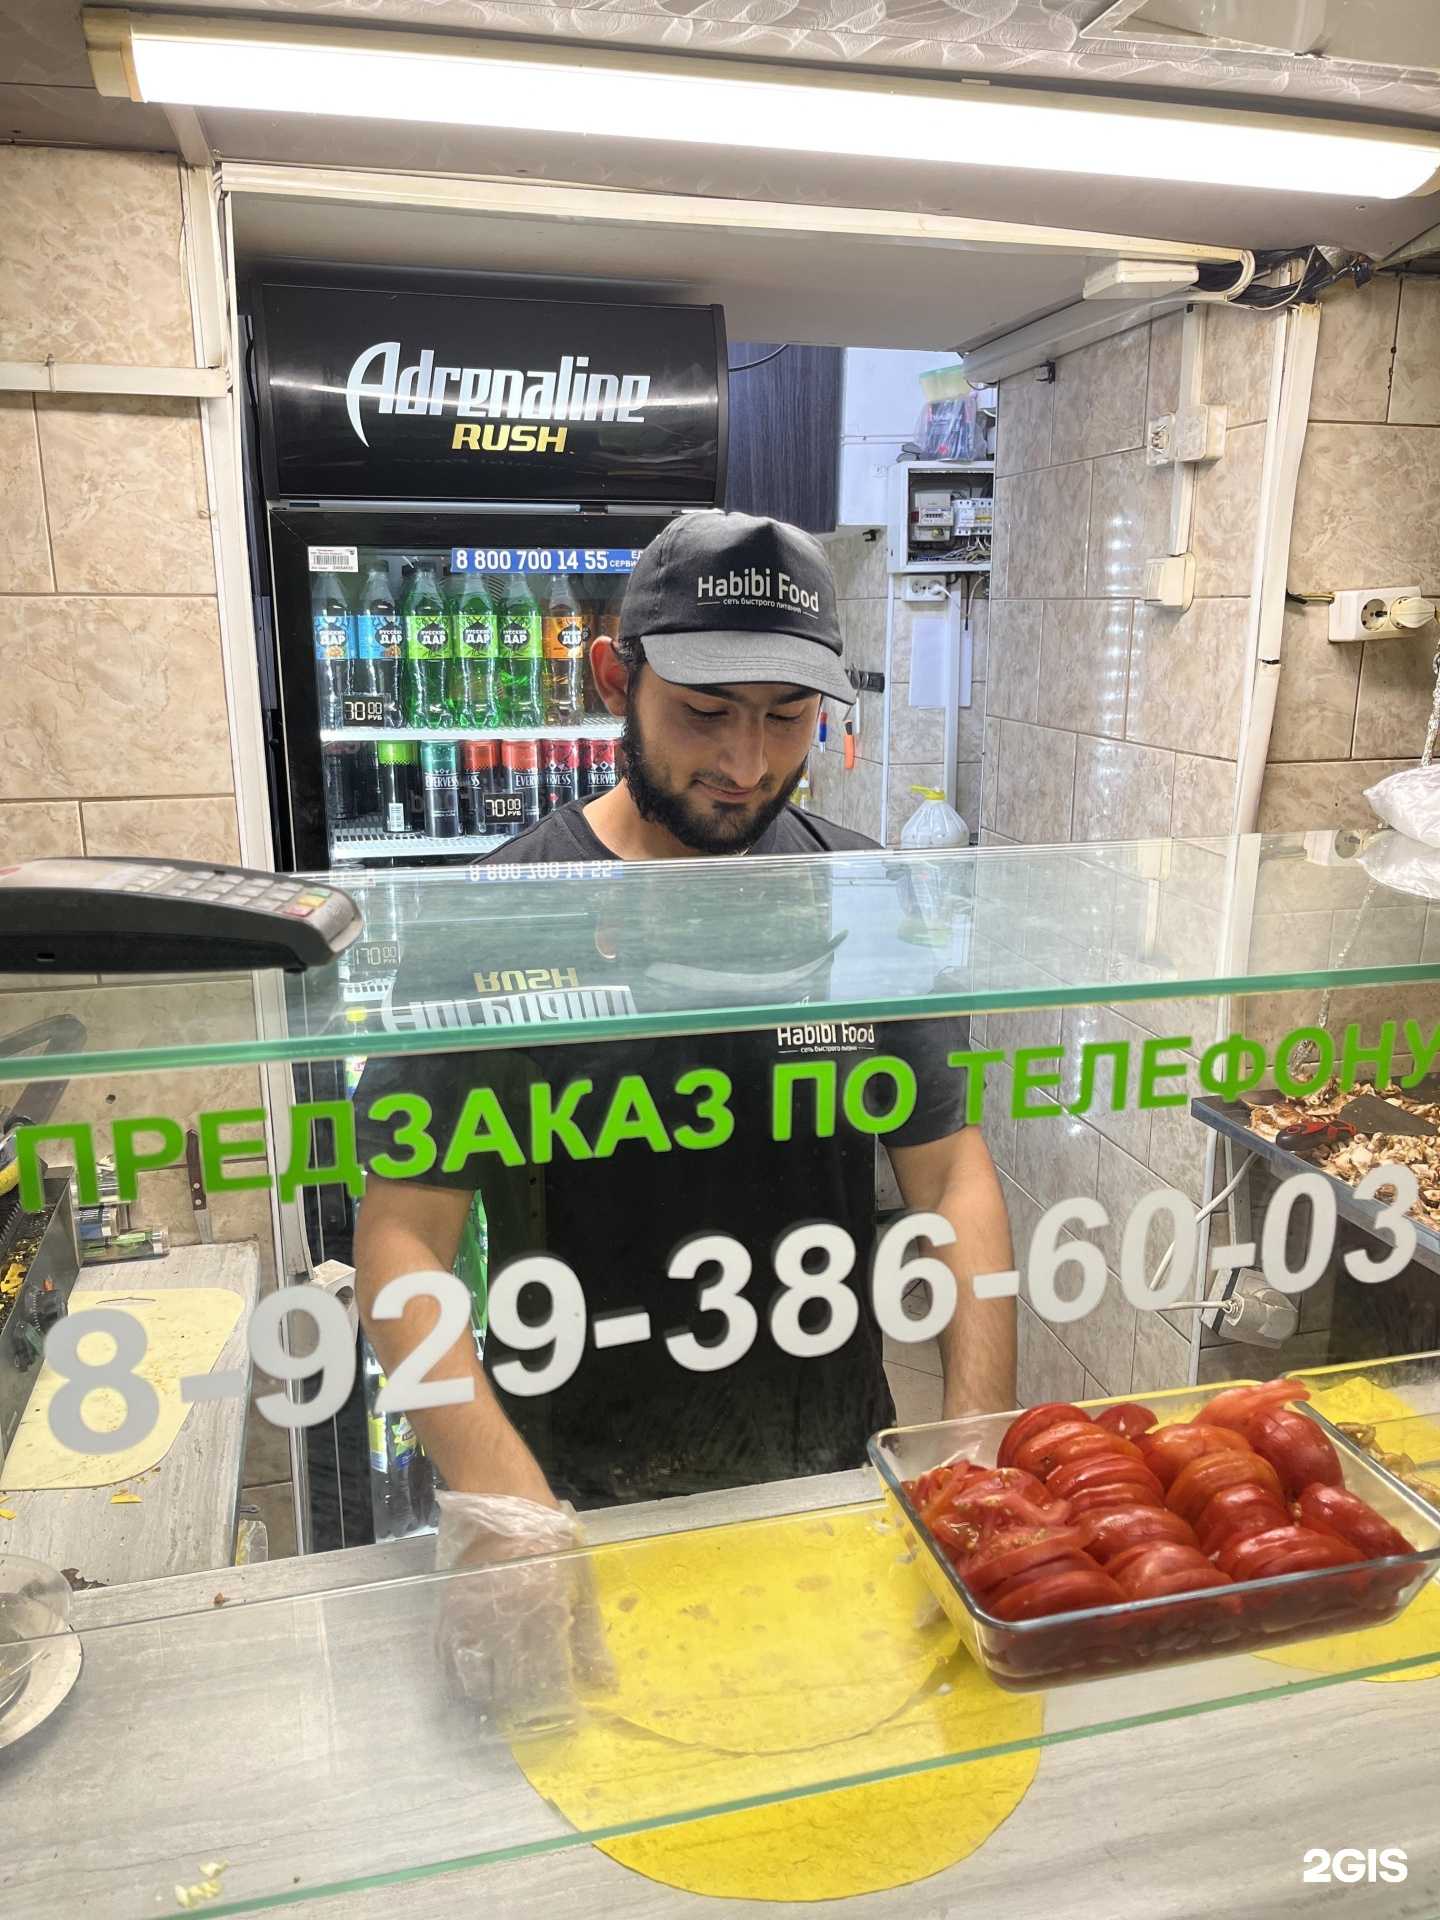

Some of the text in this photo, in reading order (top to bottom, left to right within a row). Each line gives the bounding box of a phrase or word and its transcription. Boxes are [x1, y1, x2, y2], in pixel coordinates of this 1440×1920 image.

[346, 341, 650, 448] Adrenaline
[451, 423, 568, 453] RUSH
[456, 550, 608, 570] 8 800 700 14 55
[697, 567, 820, 613] Habibi Food
[319, 635, 346, 645] ДАР
[379, 634, 403, 645] ДАР
[421, 634, 446, 645] ДАР
[465, 634, 490, 643] ДАР
[503, 634, 527, 643] ДАР
[344, 702, 366, 720] 70
[485, 798, 521, 817] 70 00
[777, 1021, 875, 1046] Habibi Food
[15, 1018, 1440, 1214] ПРЕДЗАКАЗ ПО ТЕЛЕФОНУ
[43, 1163, 1419, 1456] 8-929-386-60-03
